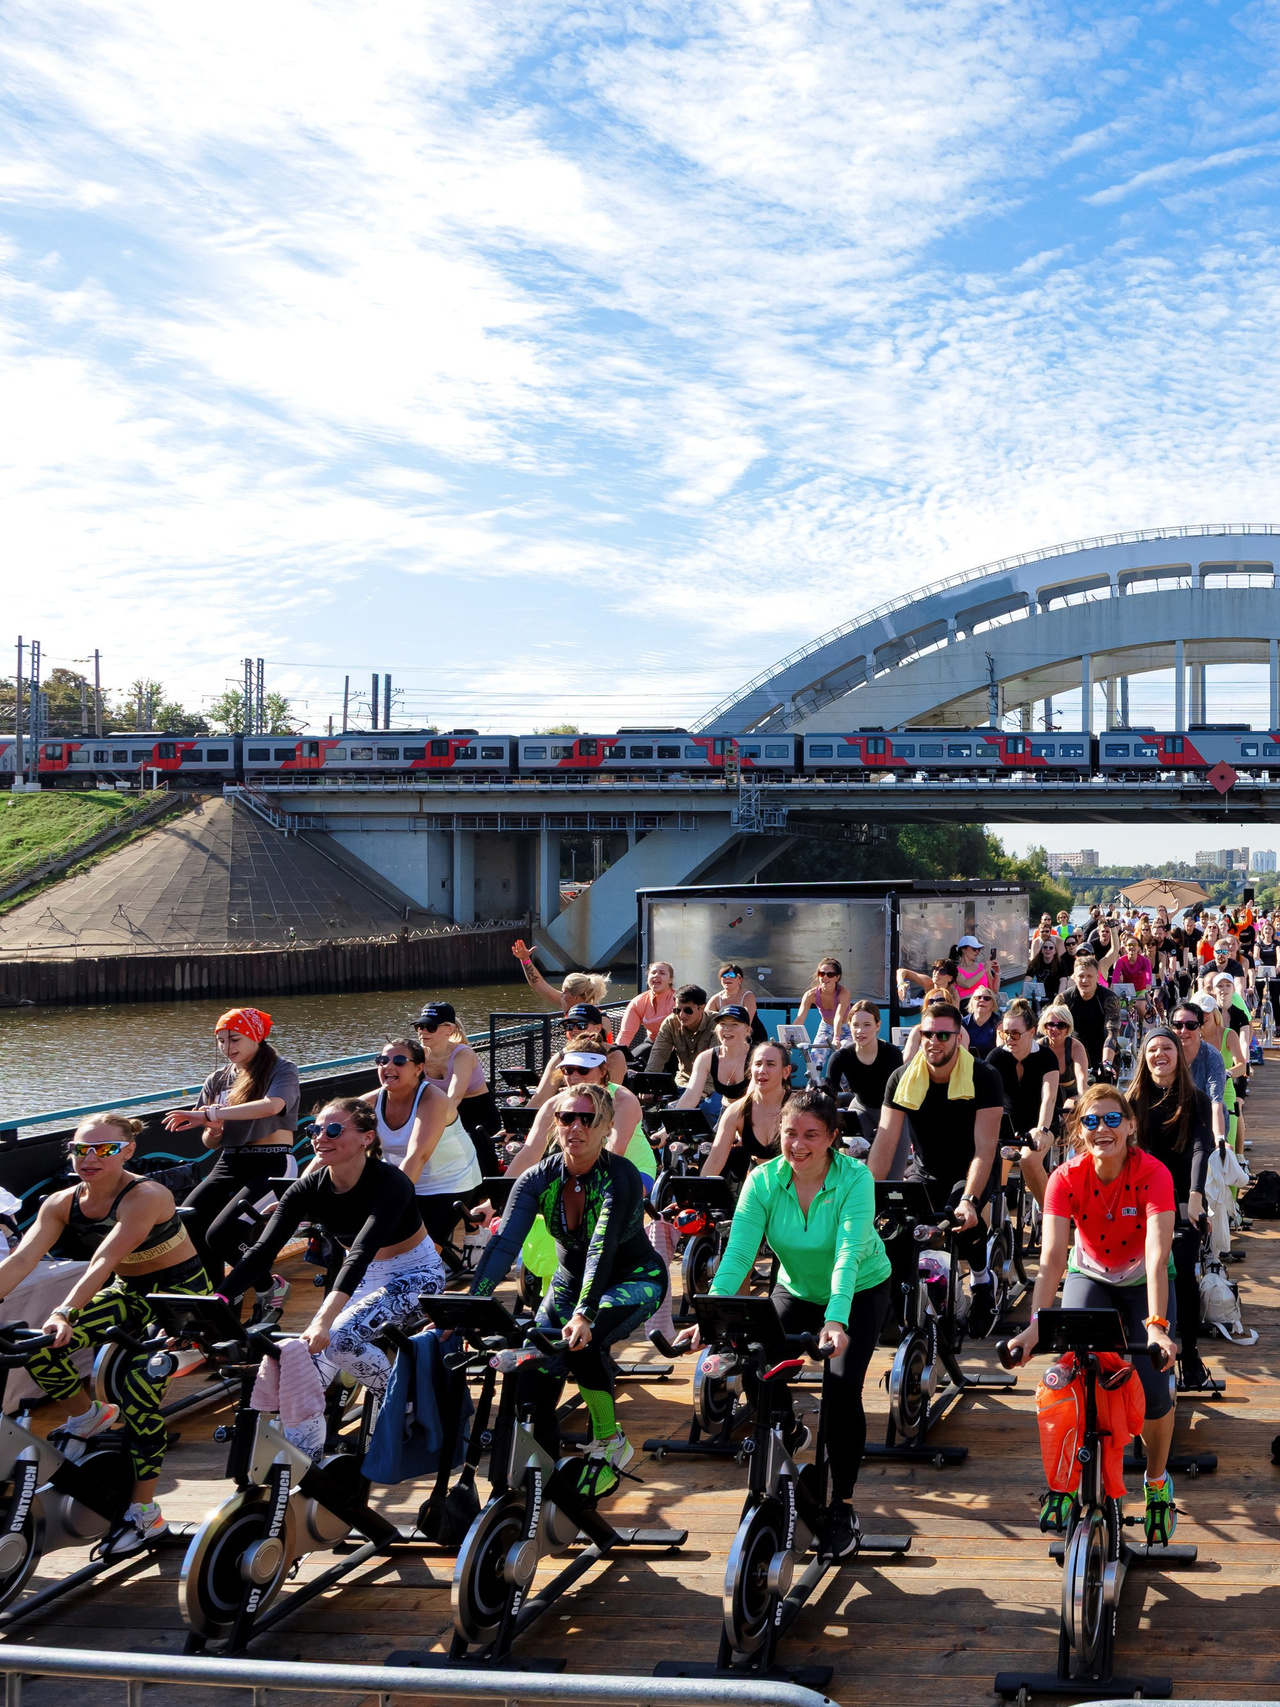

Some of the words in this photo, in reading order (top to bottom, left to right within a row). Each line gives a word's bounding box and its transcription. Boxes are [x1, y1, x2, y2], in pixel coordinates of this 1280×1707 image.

[253, 1146, 287, 1155] Kappa
[143, 1241, 172, 1259] SPORT
[339, 1389, 349, 1407] 007
[10, 1465, 37, 1532] GYMTOUCH
[269, 1470, 290, 1538] GYMTOUCH
[528, 1471, 542, 1539] GYMTOUCH
[786, 1481, 796, 1549] GYMTOUCH
[246, 1588, 262, 1613] 007
[511, 1590, 522, 1616] 007
[774, 1601, 783, 1626] 007
